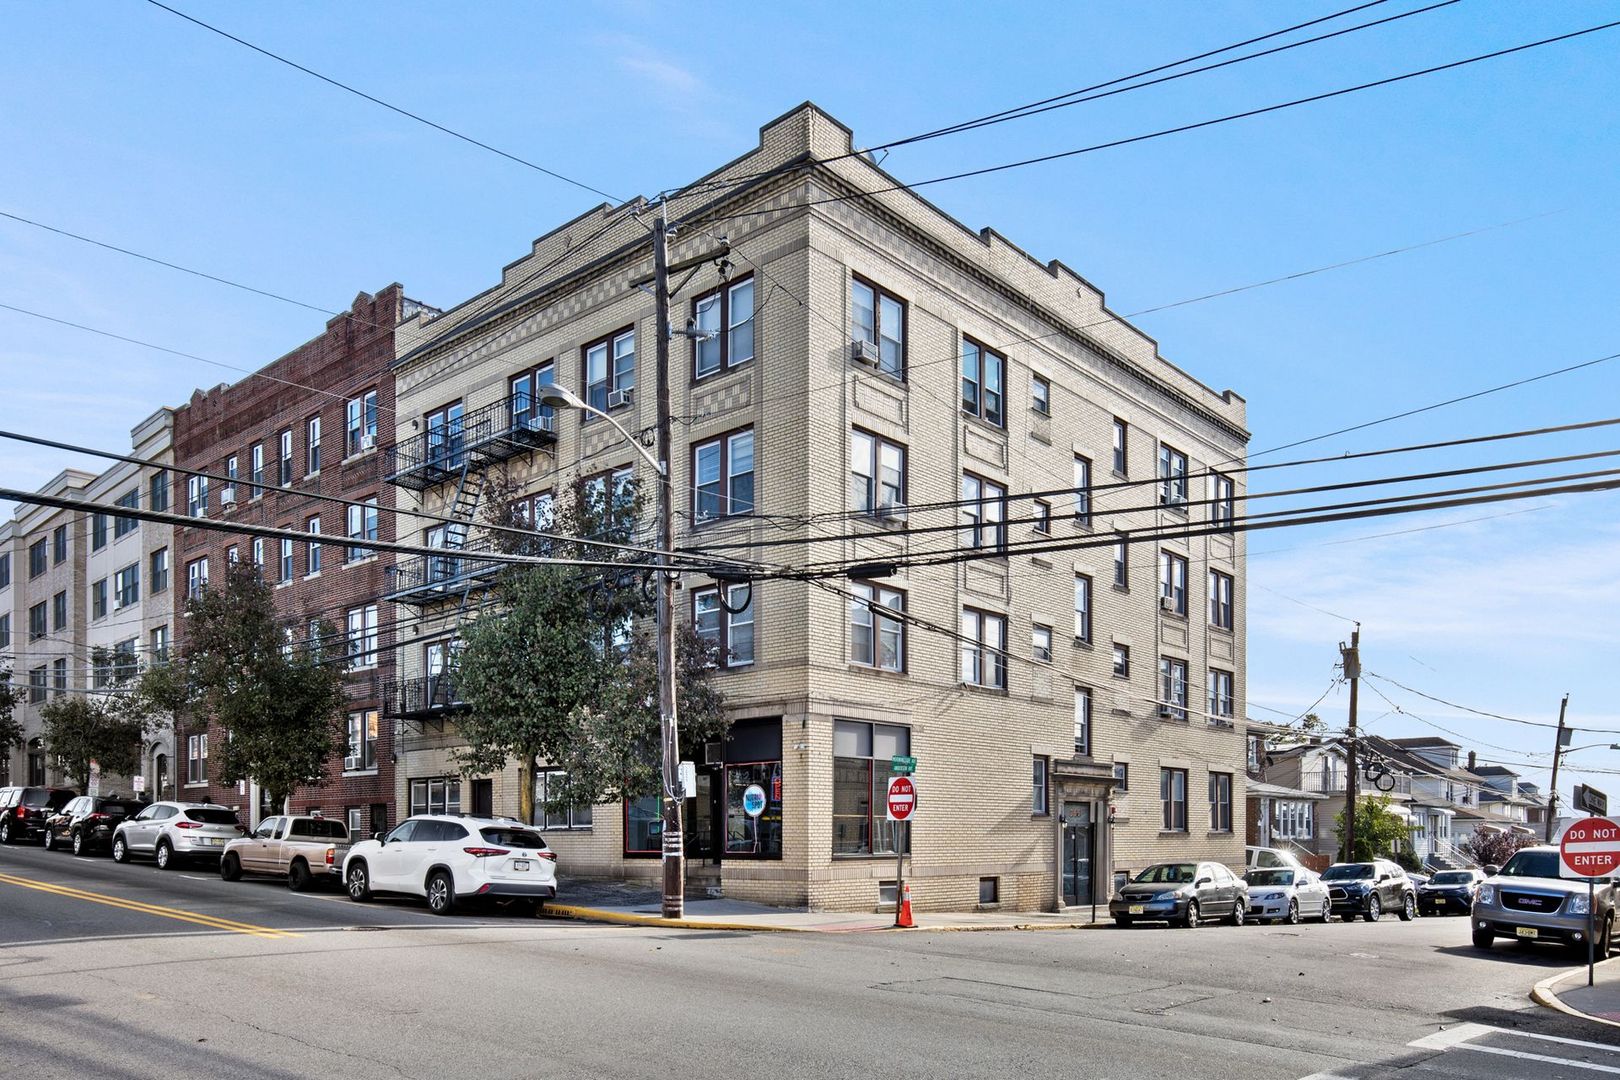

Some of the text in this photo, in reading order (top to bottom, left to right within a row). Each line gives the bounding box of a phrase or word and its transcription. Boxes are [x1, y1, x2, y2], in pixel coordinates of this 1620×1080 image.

[902, 784, 911, 792] NOT
[1570, 828, 1616, 840] DO NOT
[1574, 855, 1612, 865] ENTER
